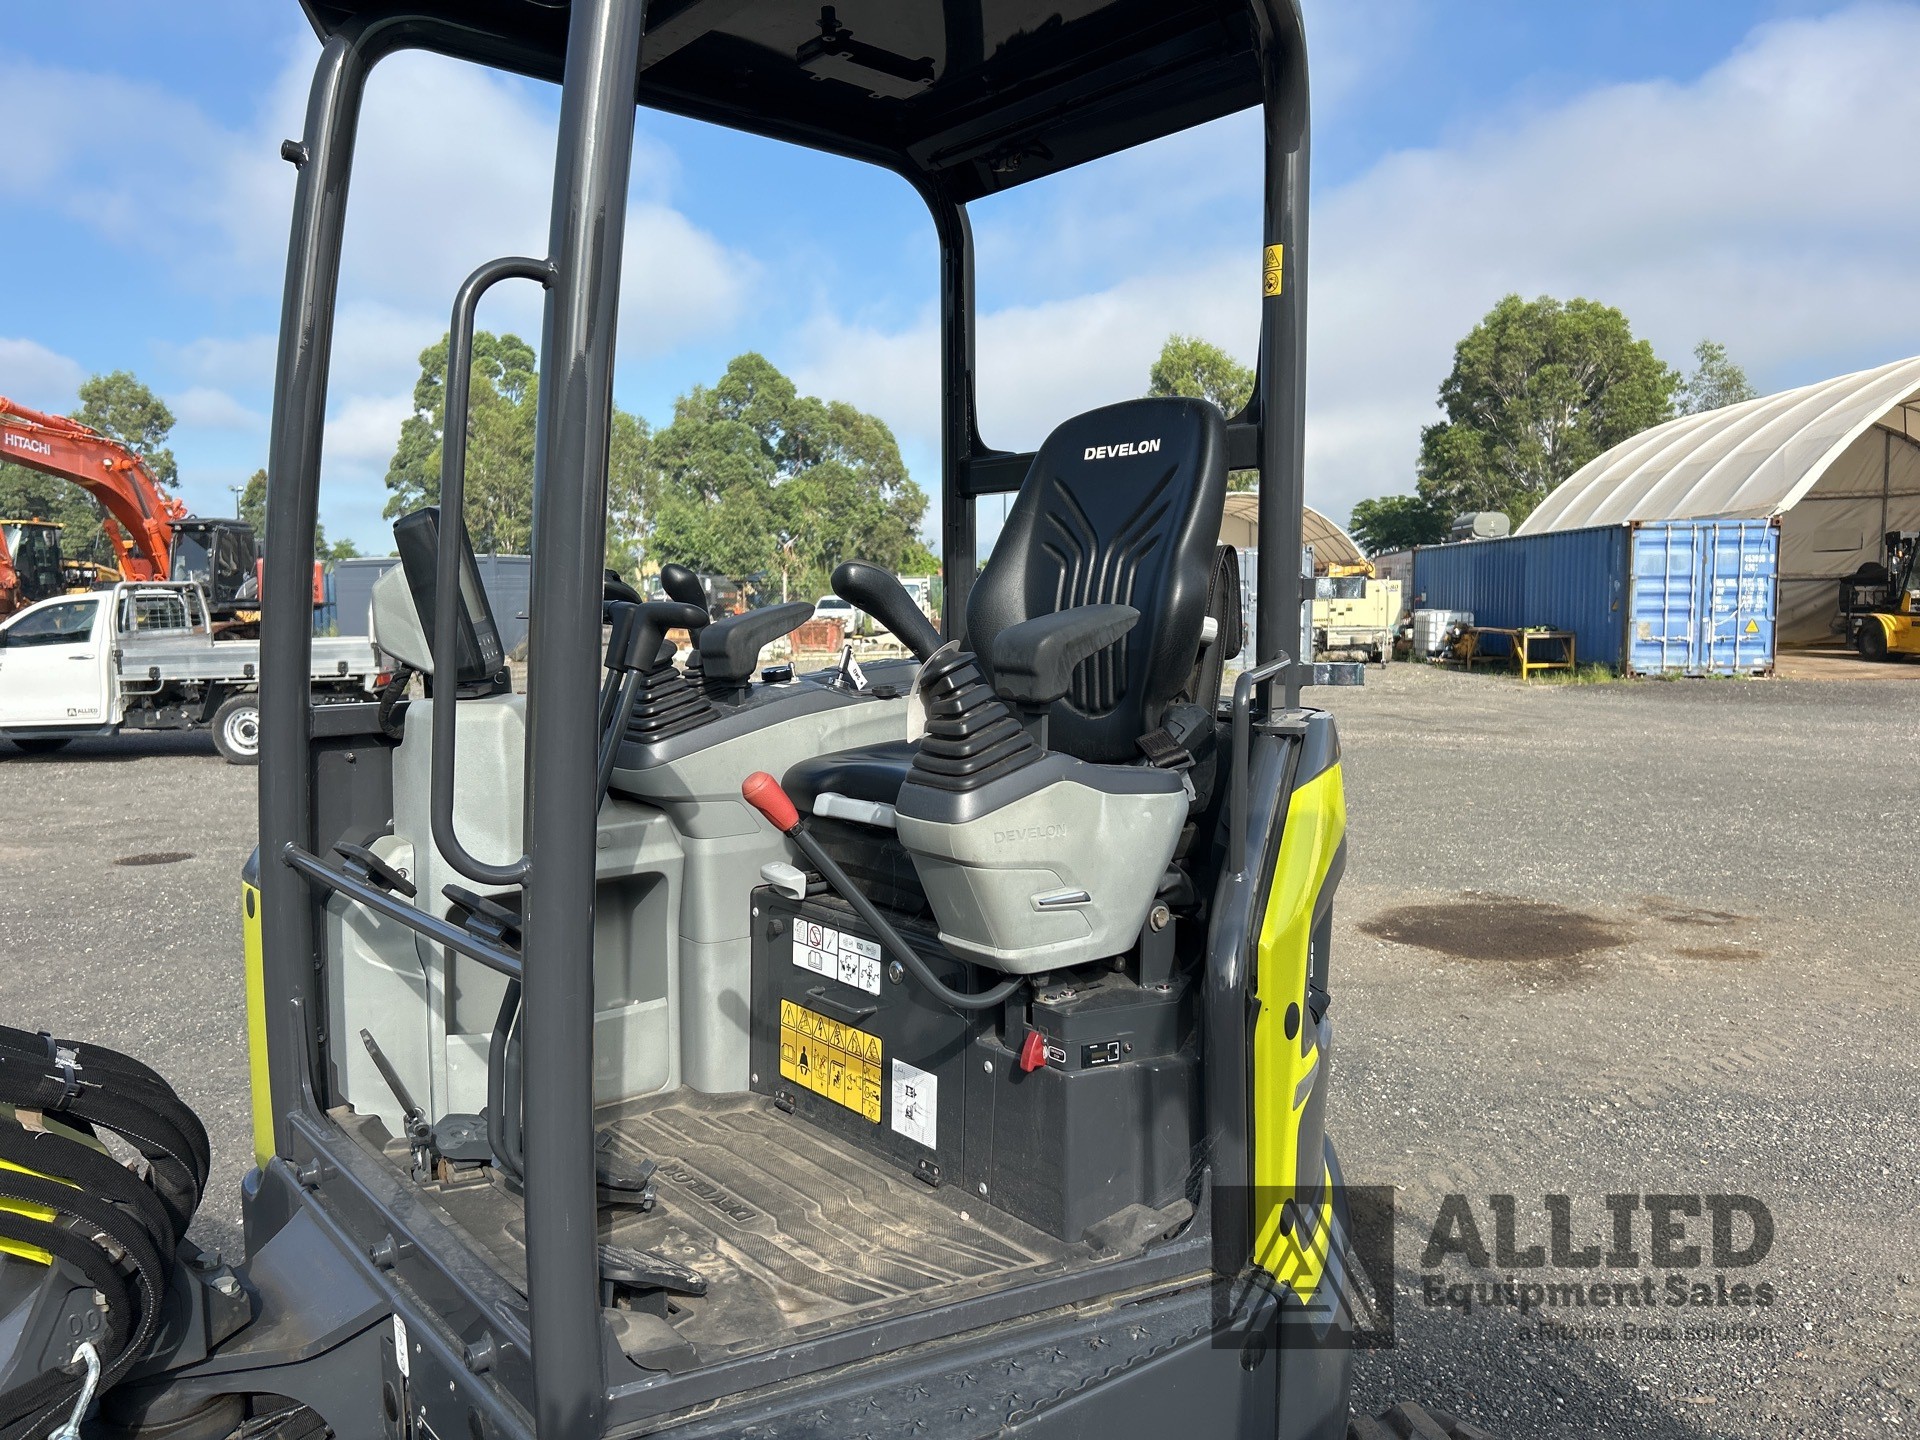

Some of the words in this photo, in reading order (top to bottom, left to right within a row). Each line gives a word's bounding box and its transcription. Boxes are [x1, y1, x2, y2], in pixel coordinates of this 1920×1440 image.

[5, 433, 50, 455] HITACHI
[1084, 438, 1160, 460] DEVELON
[994, 823, 1066, 844] DEVELON
[658, 1164, 757, 1222] DEVELON
